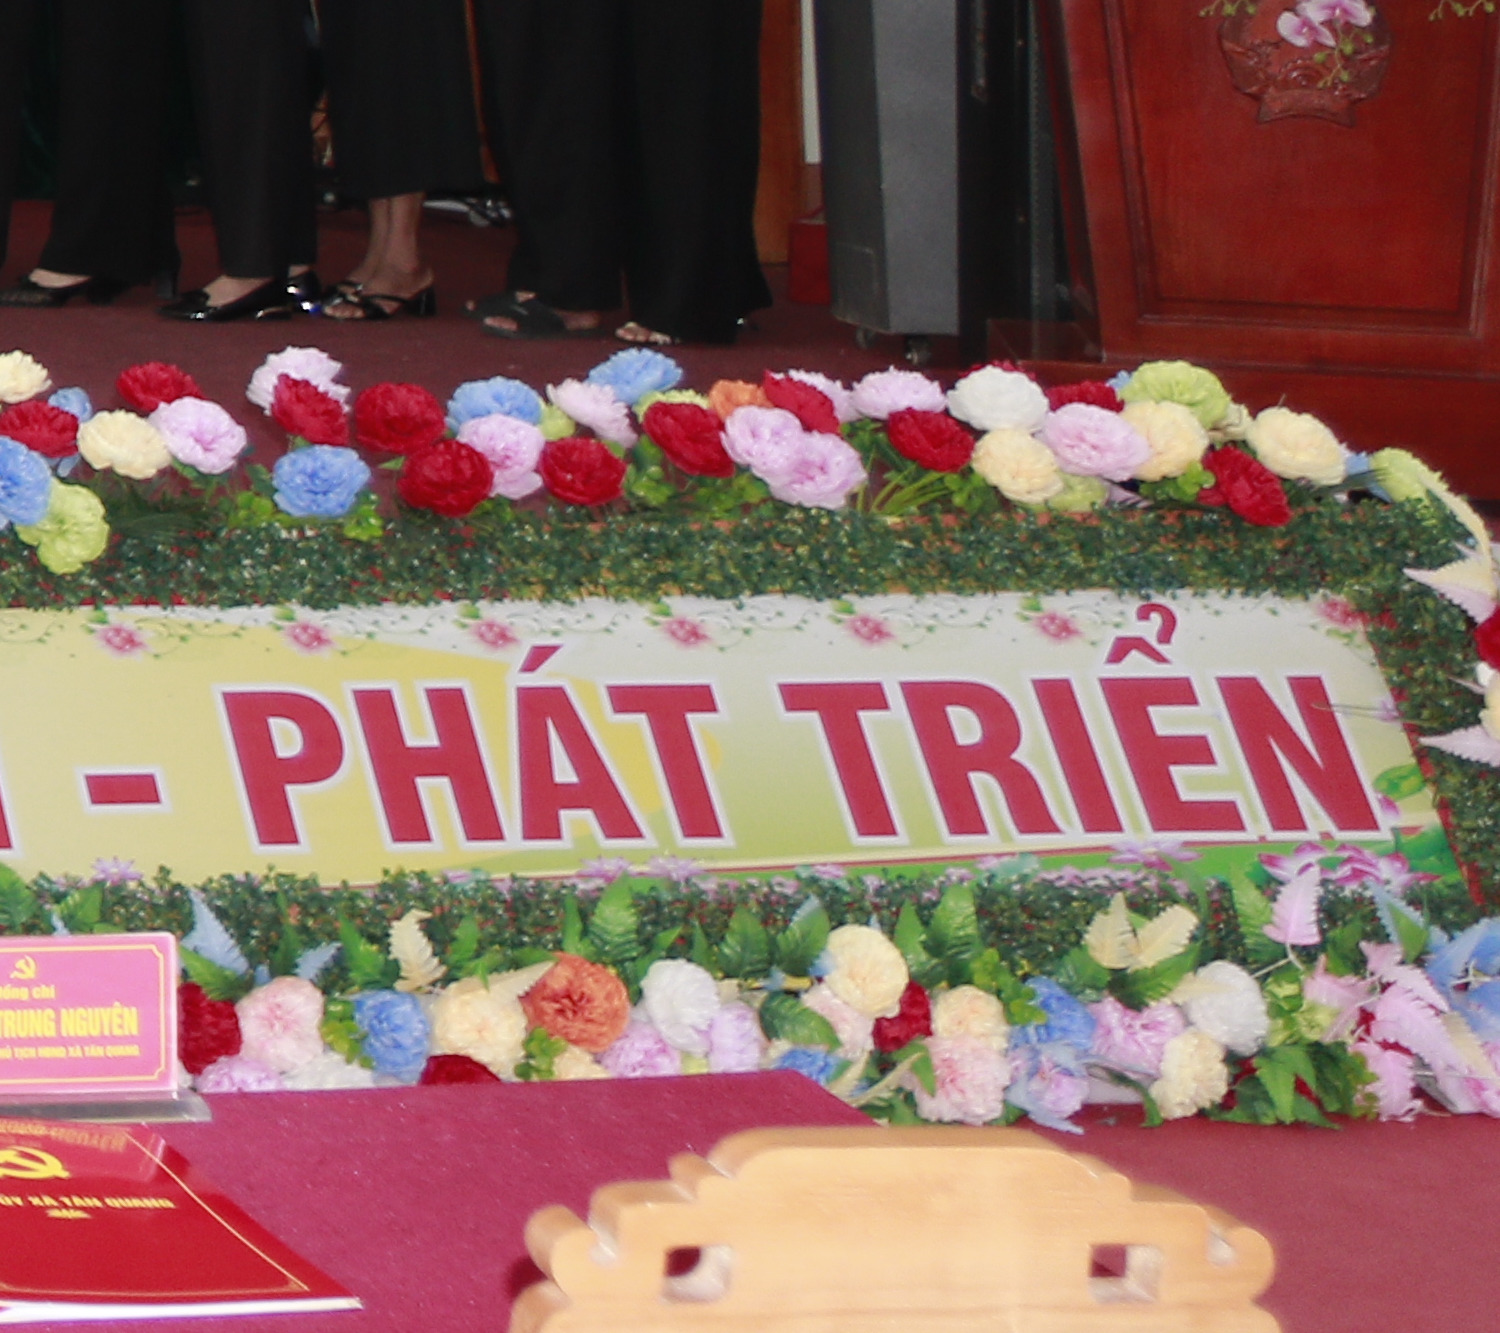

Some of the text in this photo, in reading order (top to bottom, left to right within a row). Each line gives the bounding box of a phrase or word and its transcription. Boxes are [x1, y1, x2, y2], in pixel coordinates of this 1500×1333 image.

[227, 647, 721, 844] PHÁT
[784, 603, 1378, 836] TRIỂN
[60, 1001, 139, 1037] NGUYÊN
